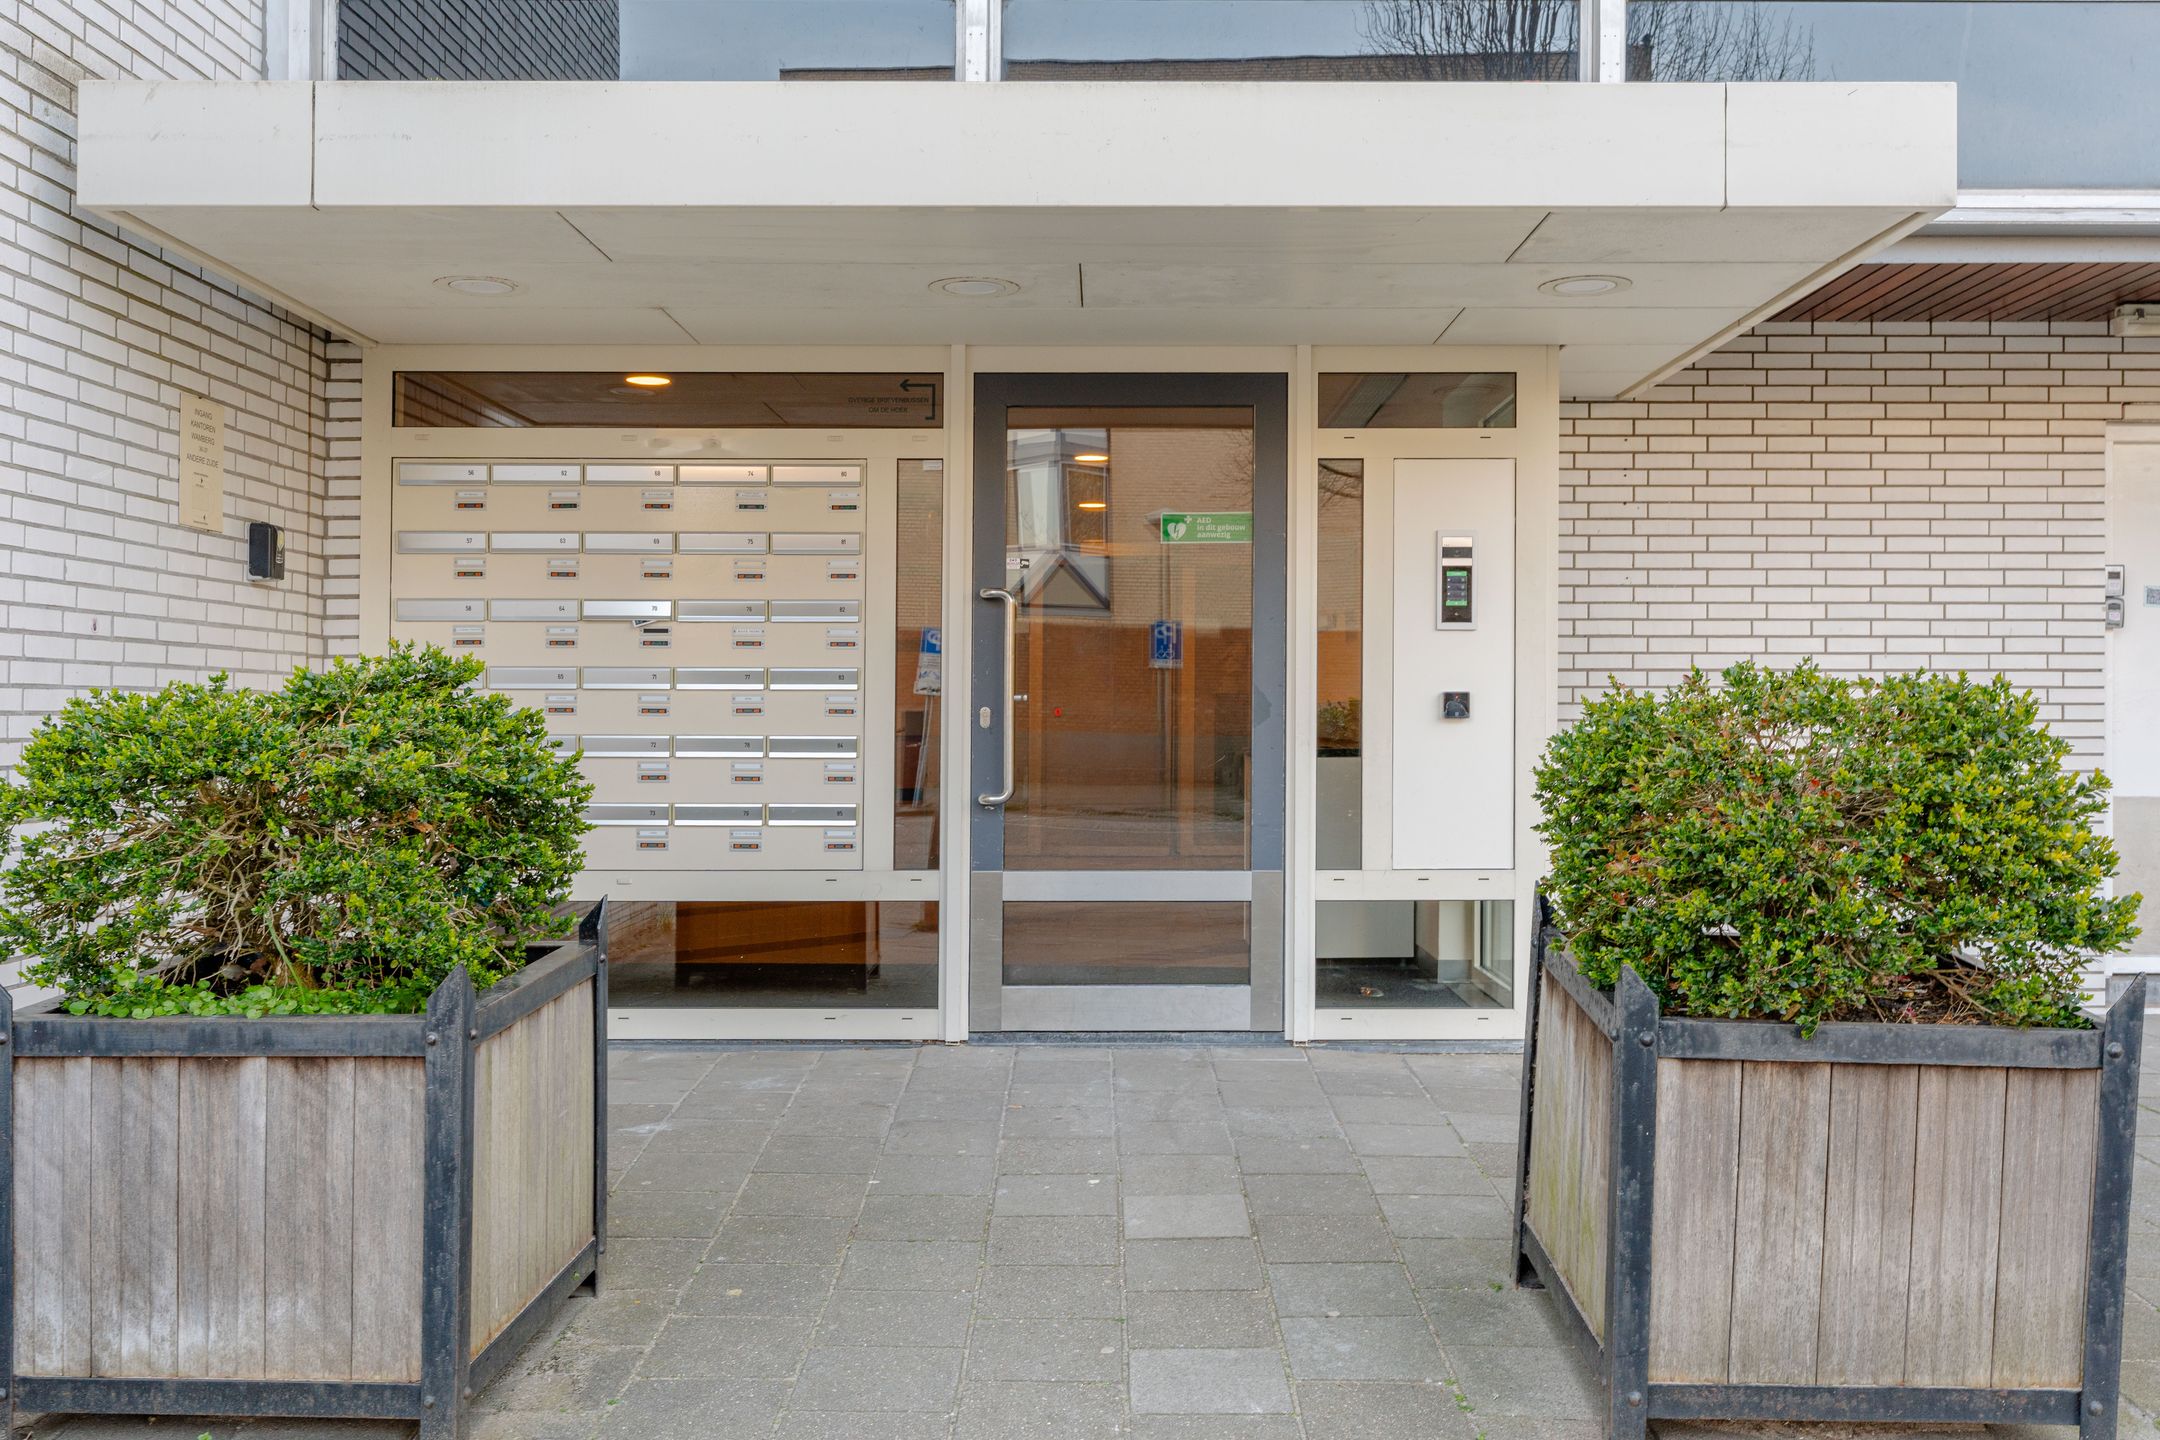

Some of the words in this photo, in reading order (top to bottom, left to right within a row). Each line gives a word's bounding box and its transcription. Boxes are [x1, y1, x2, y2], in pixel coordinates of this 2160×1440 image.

[194, 408, 213, 421] INGANG
[190, 419, 216, 434] KANTOREN
[186, 452, 206, 465] ANDERE
[1217, 524, 1246, 532] gebouw
[1196, 531, 1231, 539] aanwezig
